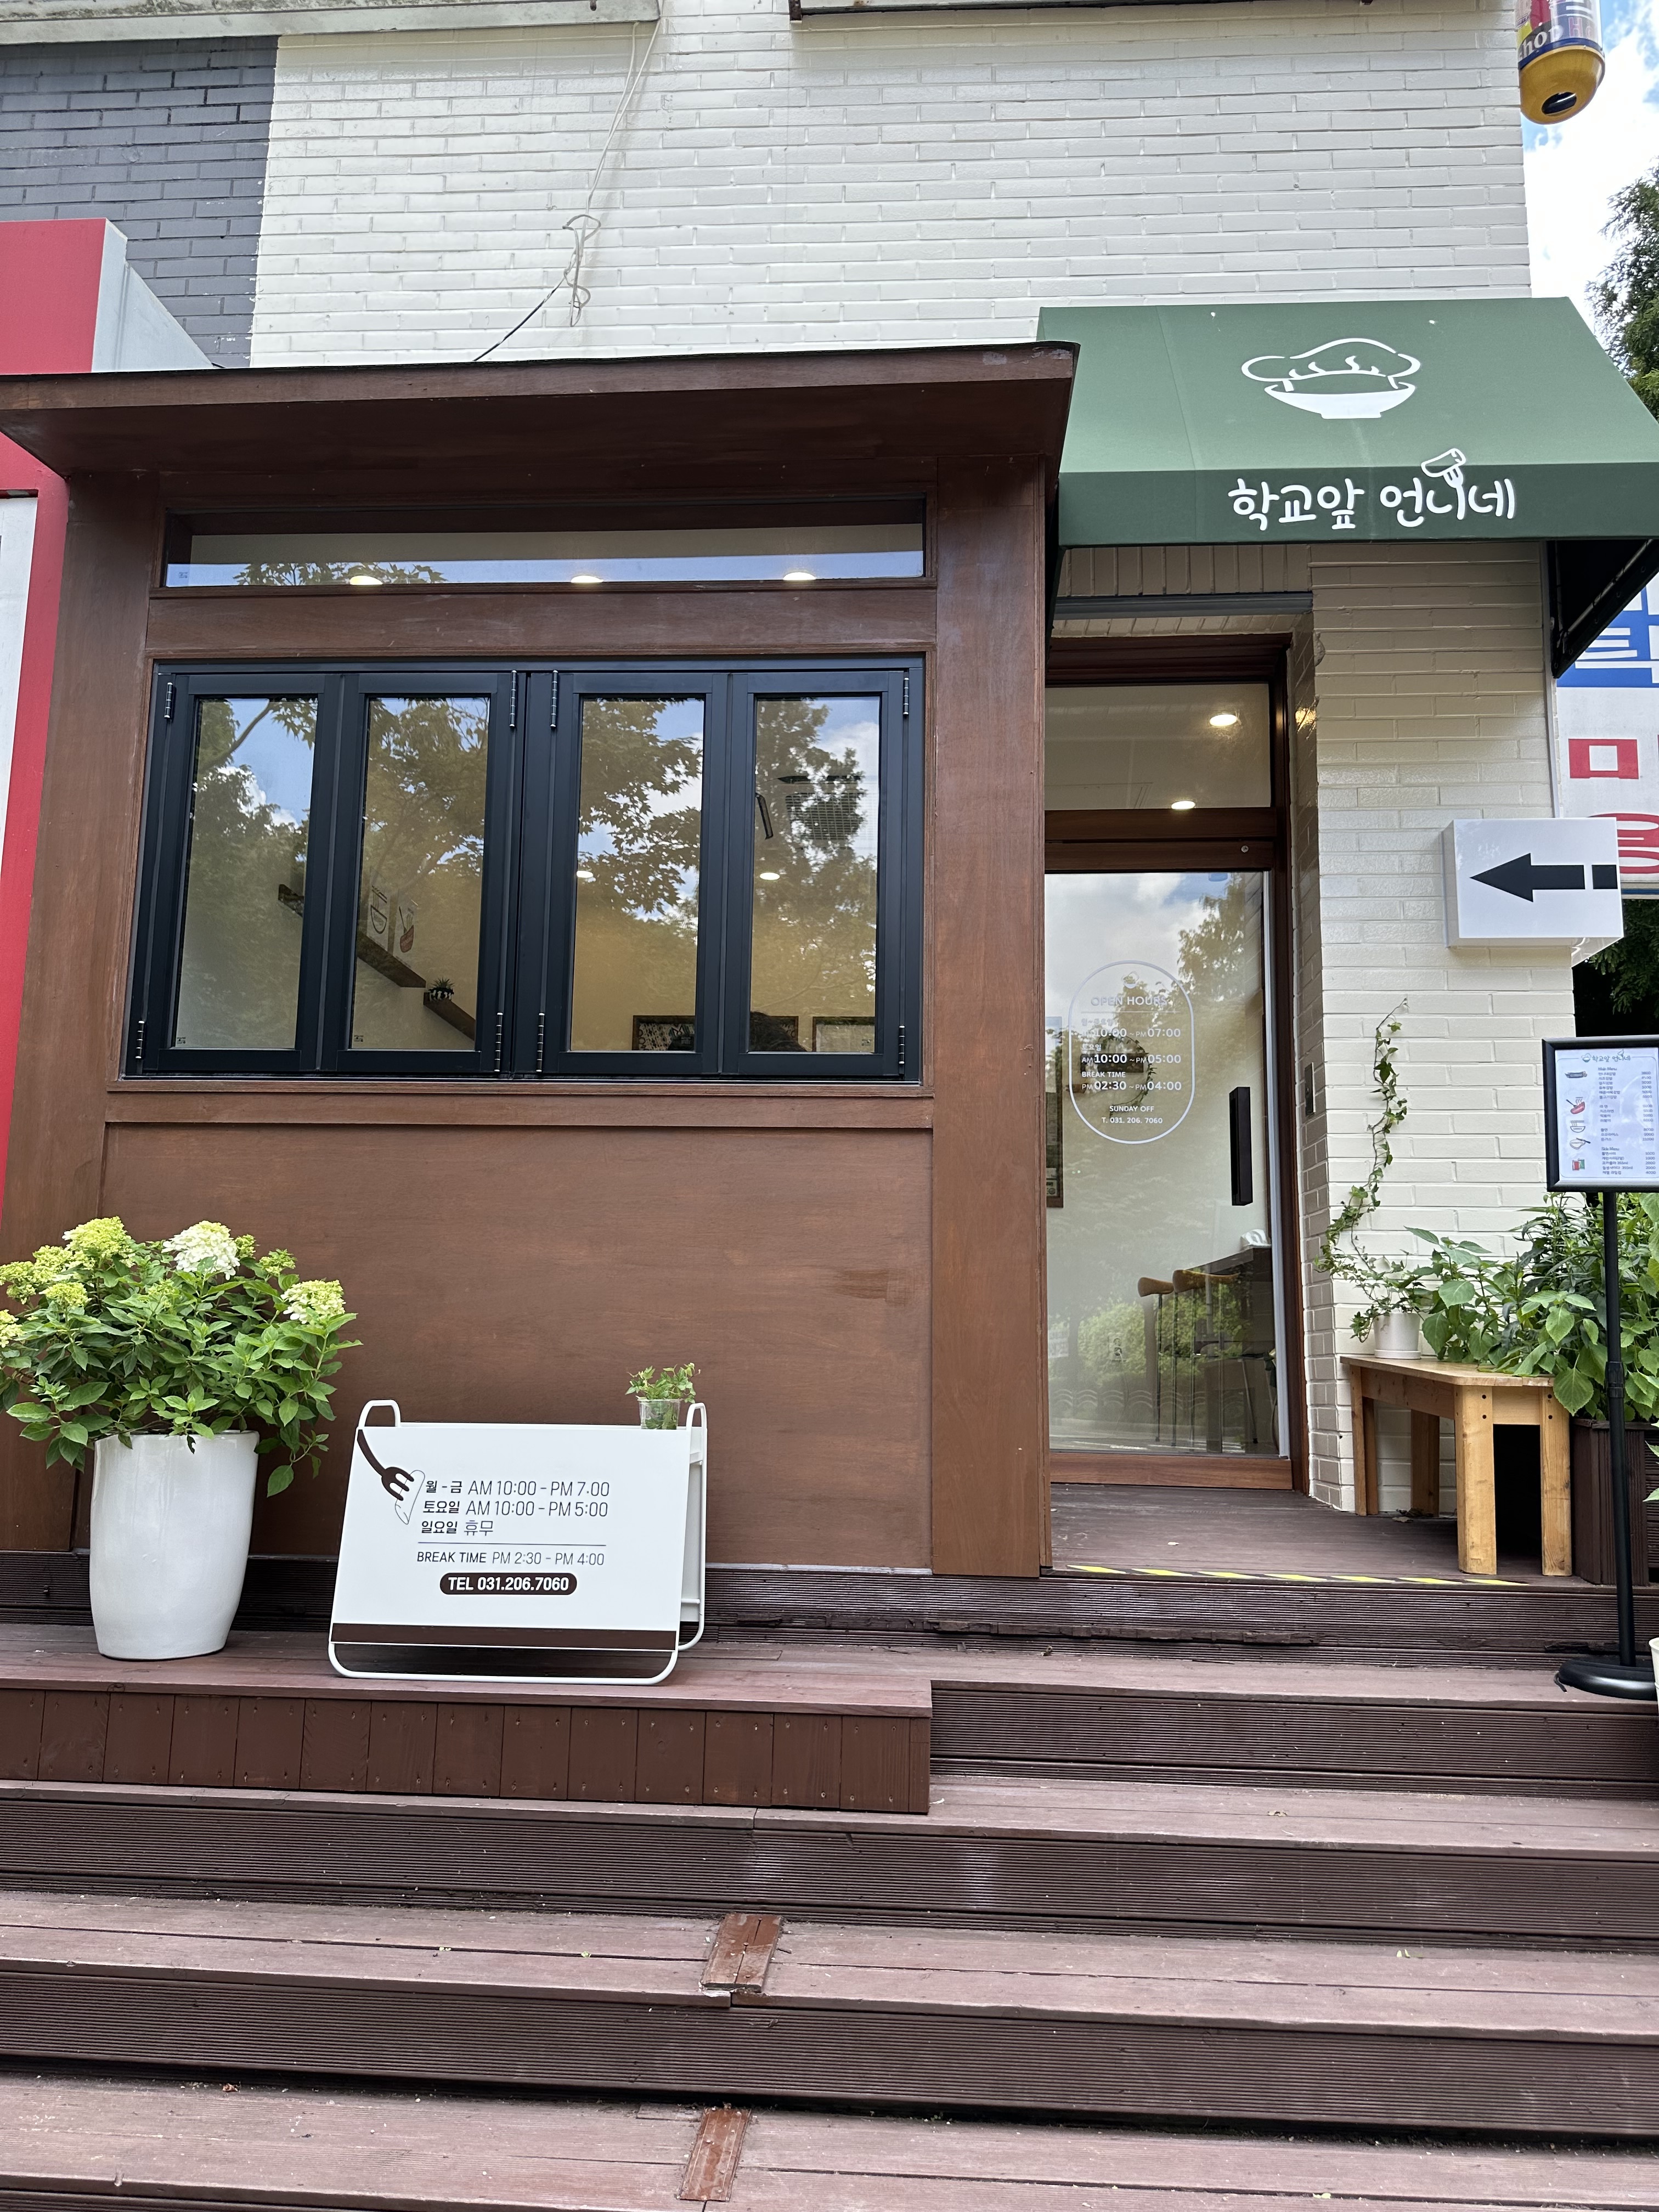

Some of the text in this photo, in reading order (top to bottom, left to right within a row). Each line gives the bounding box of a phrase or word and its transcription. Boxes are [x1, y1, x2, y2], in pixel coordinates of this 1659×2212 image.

[1228, 473, 1515, 531] 학교앞 언니네
[1091, 996, 1167, 1006] OPEN HOURS
[426, 1480, 437, 1493] 월
[450, 1481, 462, 1493] 금
[468, 1480, 493, 1495] AM
[497, 1481, 537, 1496] 10:00
[550, 1481, 573, 1496] PM
[422, 1500, 460, 1514] 토요일
[465, 1500, 490, 1515] AM
[495, 1500, 534, 1516] 10:00
[549, 1502, 571, 1516] PM
[574, 1502, 608, 1517] 5:00
[421, 1520, 494, 1536] 일요일 휴무
[417, 1551, 456, 1562] BREAK
[459, 1552, 487, 1563] TIME
[492, 1551, 511, 1564] PM
[514, 1551, 541, 1564] 2:30
[555, 1553, 573, 1565] PM
[577, 1553, 605, 1565] 4:00
[448, 1577, 569, 1591] TEL 031.206.7060
